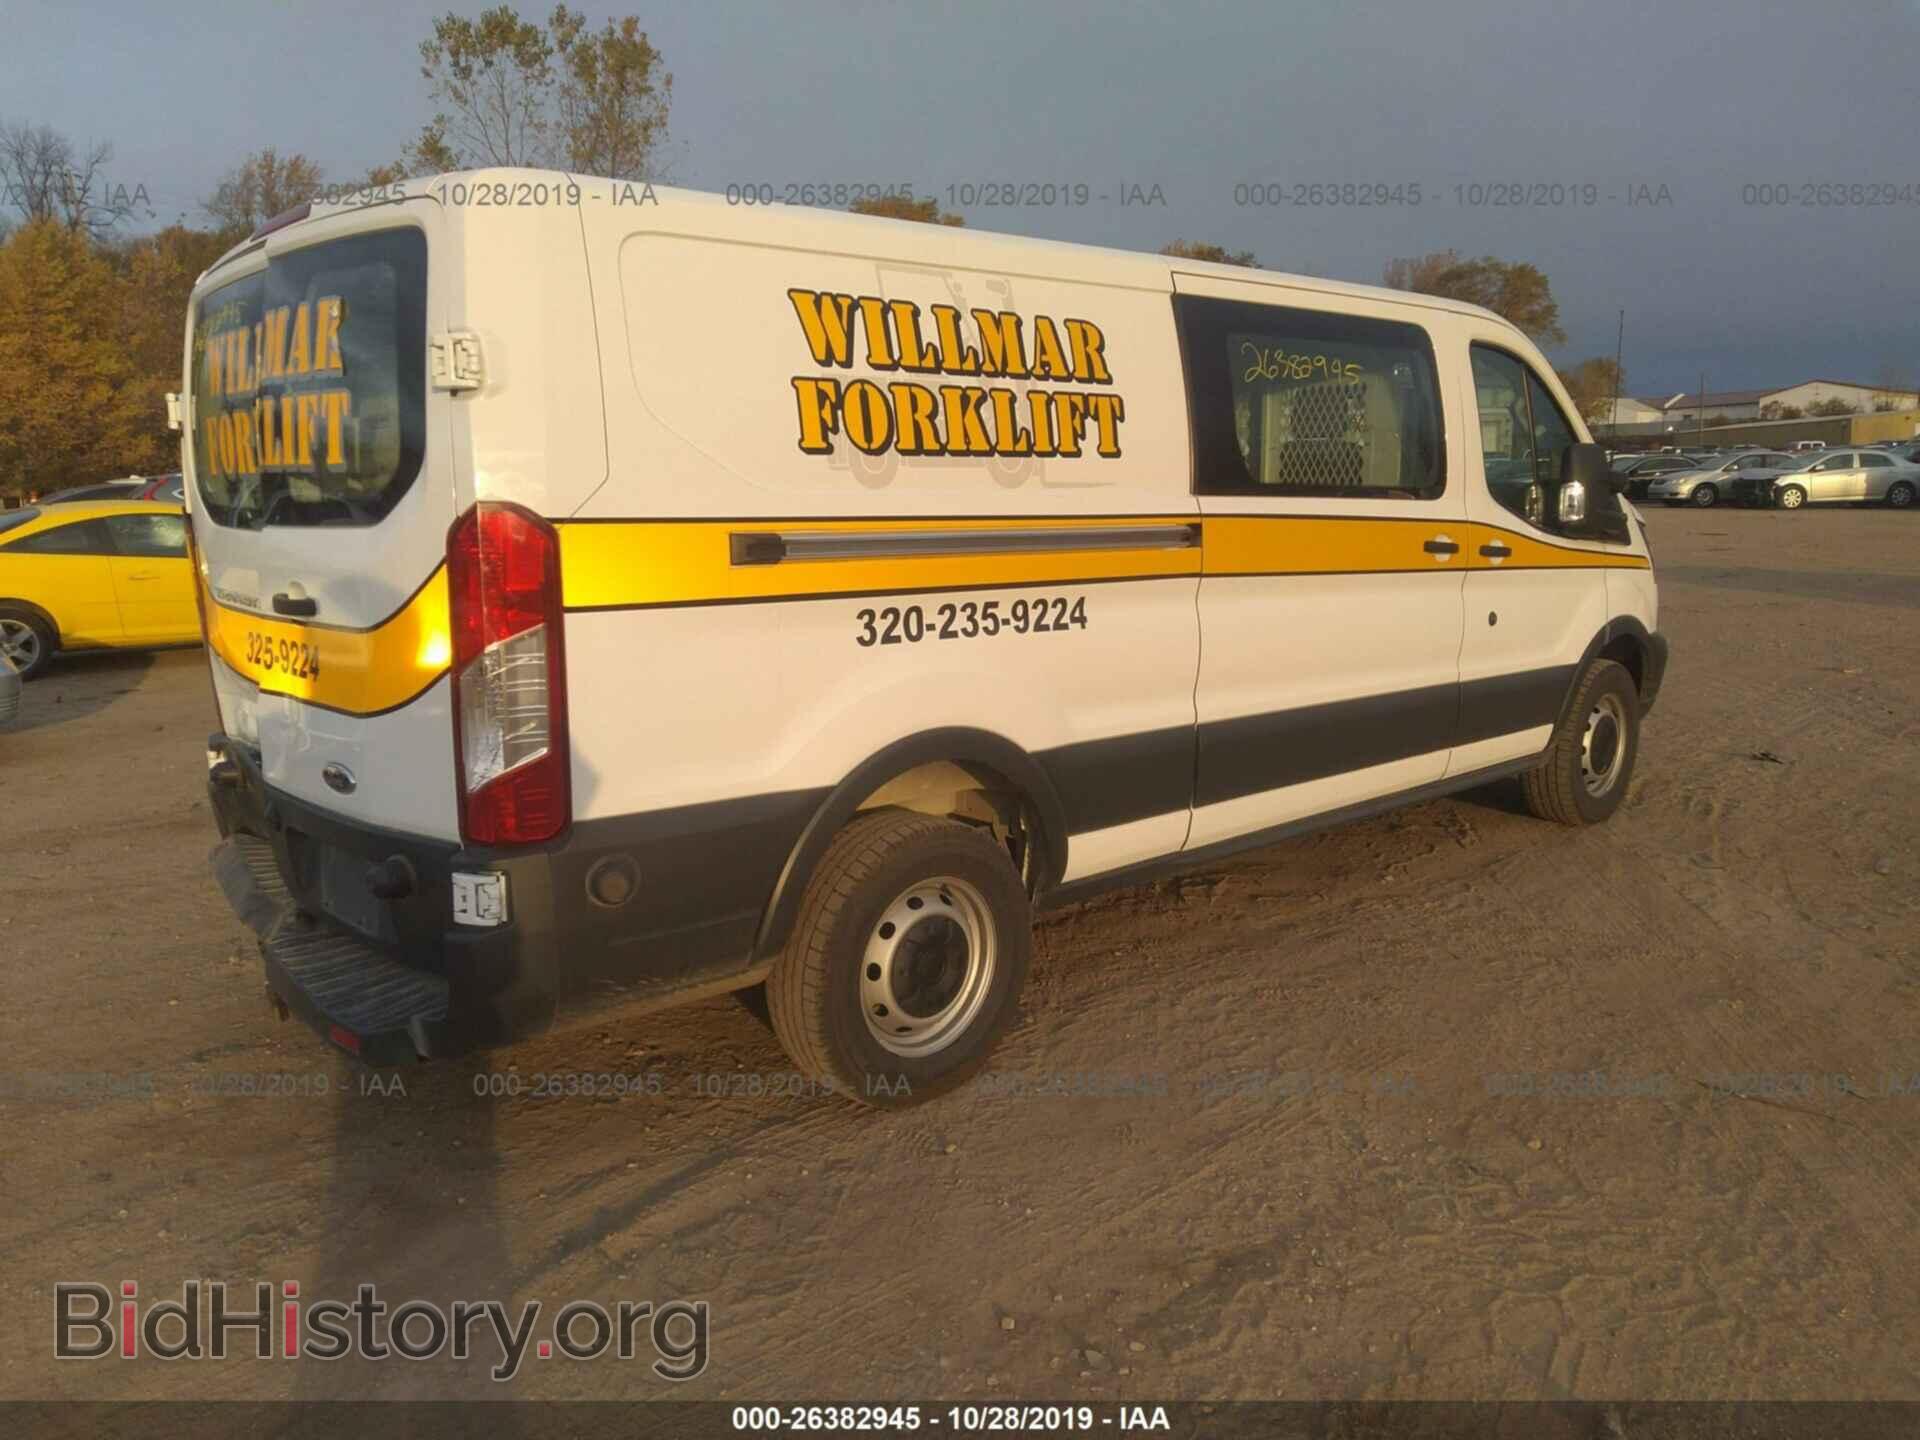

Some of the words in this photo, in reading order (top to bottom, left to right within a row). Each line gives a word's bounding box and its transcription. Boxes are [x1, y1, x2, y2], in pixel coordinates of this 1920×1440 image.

[788, 288, 1113, 385] WILLMAR
[791, 376, 1125, 458] FORKLIFT
[856, 597, 1088, 647] 320-235-9224
[247, 631, 320, 682] 325-9224
